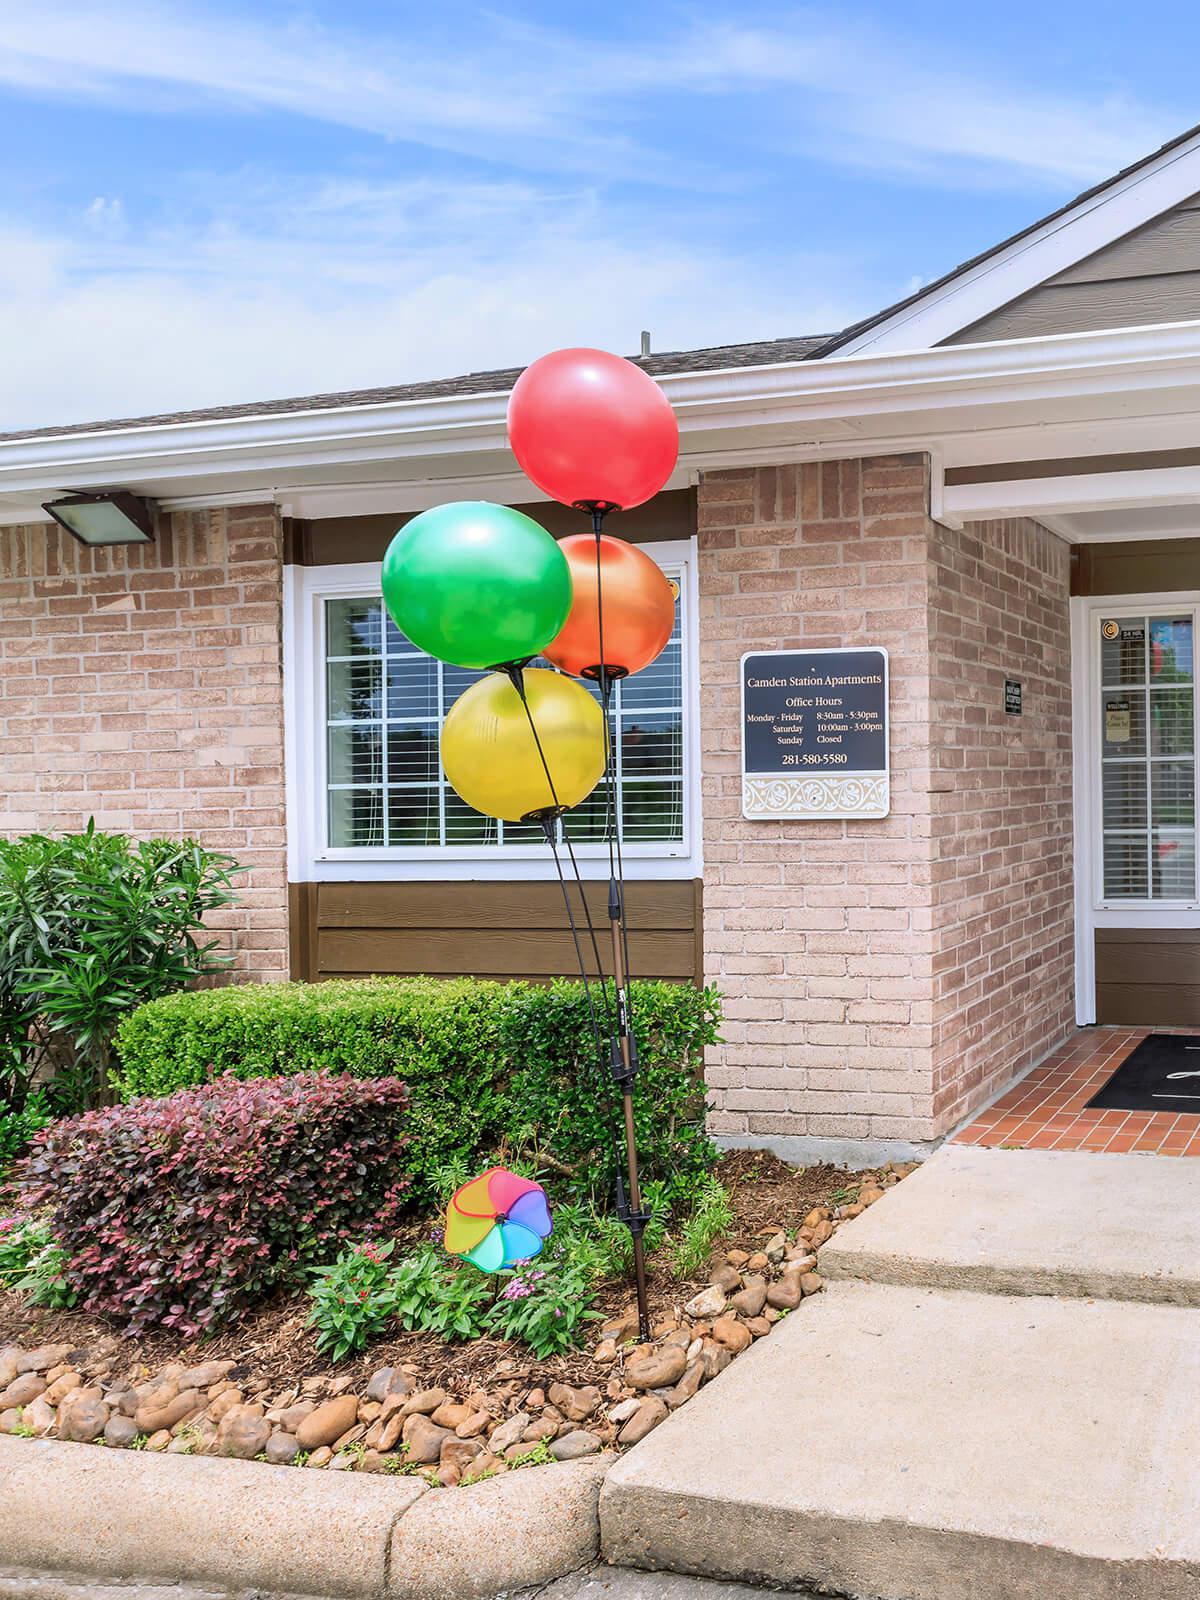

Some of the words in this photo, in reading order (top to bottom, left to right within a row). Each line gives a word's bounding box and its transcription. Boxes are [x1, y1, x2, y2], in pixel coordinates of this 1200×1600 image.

[747, 677, 787, 688] Camden
[789, 676, 823, 687] Station
[824, 674, 882, 688] Apartments
[785, 697, 813, 707] Office
[815, 697, 843, 706] Hours
[746, 714, 775, 723] Monday
[781, 713, 803, 723] Friday
[849, 711, 878, 720] 5:30pm
[772, 725, 804, 734] Saturday
[817, 723, 849, 732] 10:00am
[854, 723, 883, 733] 3:00pm
[777, 736, 804, 746] Sunday
[816, 735, 842, 744] Closed
[782, 753, 848, 765] 281-580-5580
